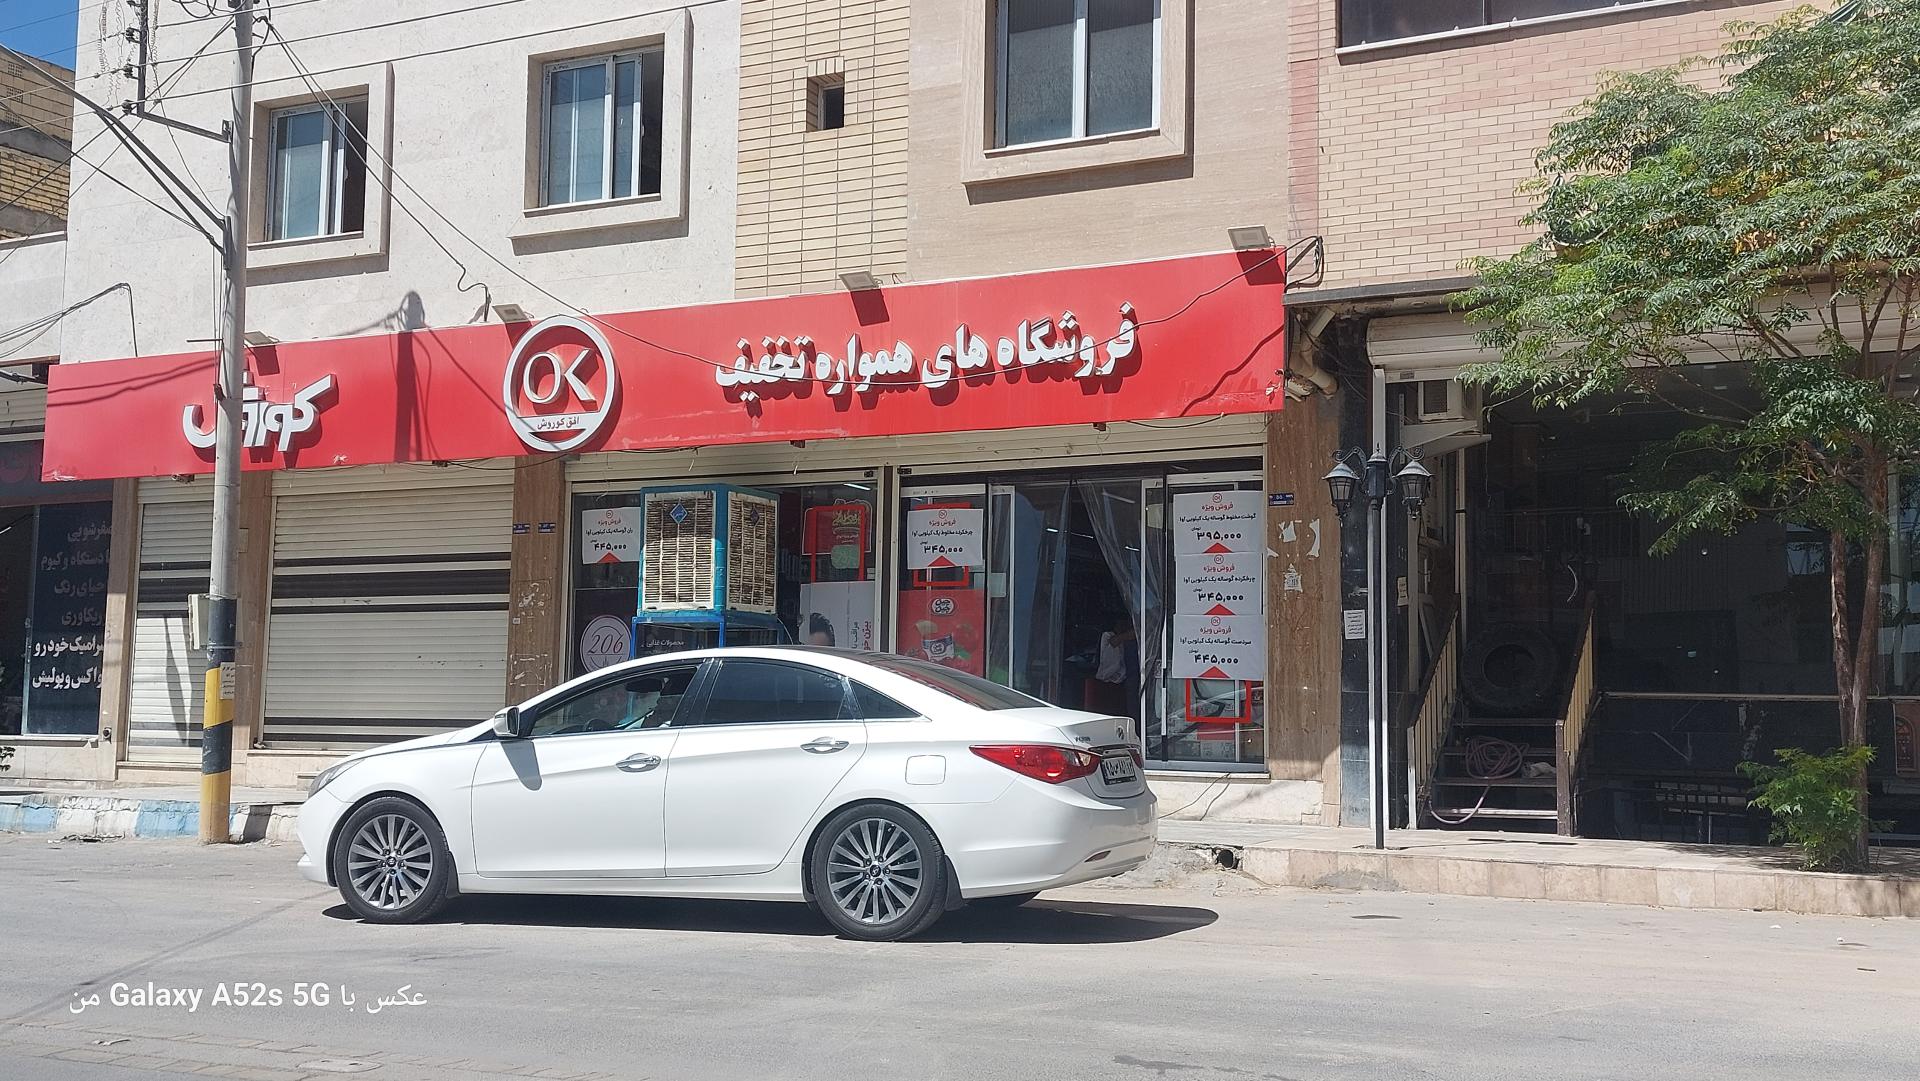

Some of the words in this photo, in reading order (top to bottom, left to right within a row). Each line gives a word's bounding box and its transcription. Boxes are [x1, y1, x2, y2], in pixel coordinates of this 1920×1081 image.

[997, 300, 1136, 378] فروشگاه
[921, 322, 989, 389] های
[714, 334, 814, 402] تخفیف
[815, 333, 913, 395] همواره
[523, 347, 597, 404] OK
[537, 417, 565, 430] کوروش
[566, 416, 580, 428] افق
[1201, 504, 1215, 512] ویژه
[1214, 502, 1234, 511] فروش
[608, 517, 621, 526] فروش
[929, 519, 940, 527] ویژه
[940, 518, 956, 526] فروش
[70, 550, 104, 566] دستگاه
[1217, 563, 1235, 572] فروش
[1200, 627, 1213, 635] ویژه
[1213, 626, 1232, 634] فروش
[587, 633, 625, 654] 206
